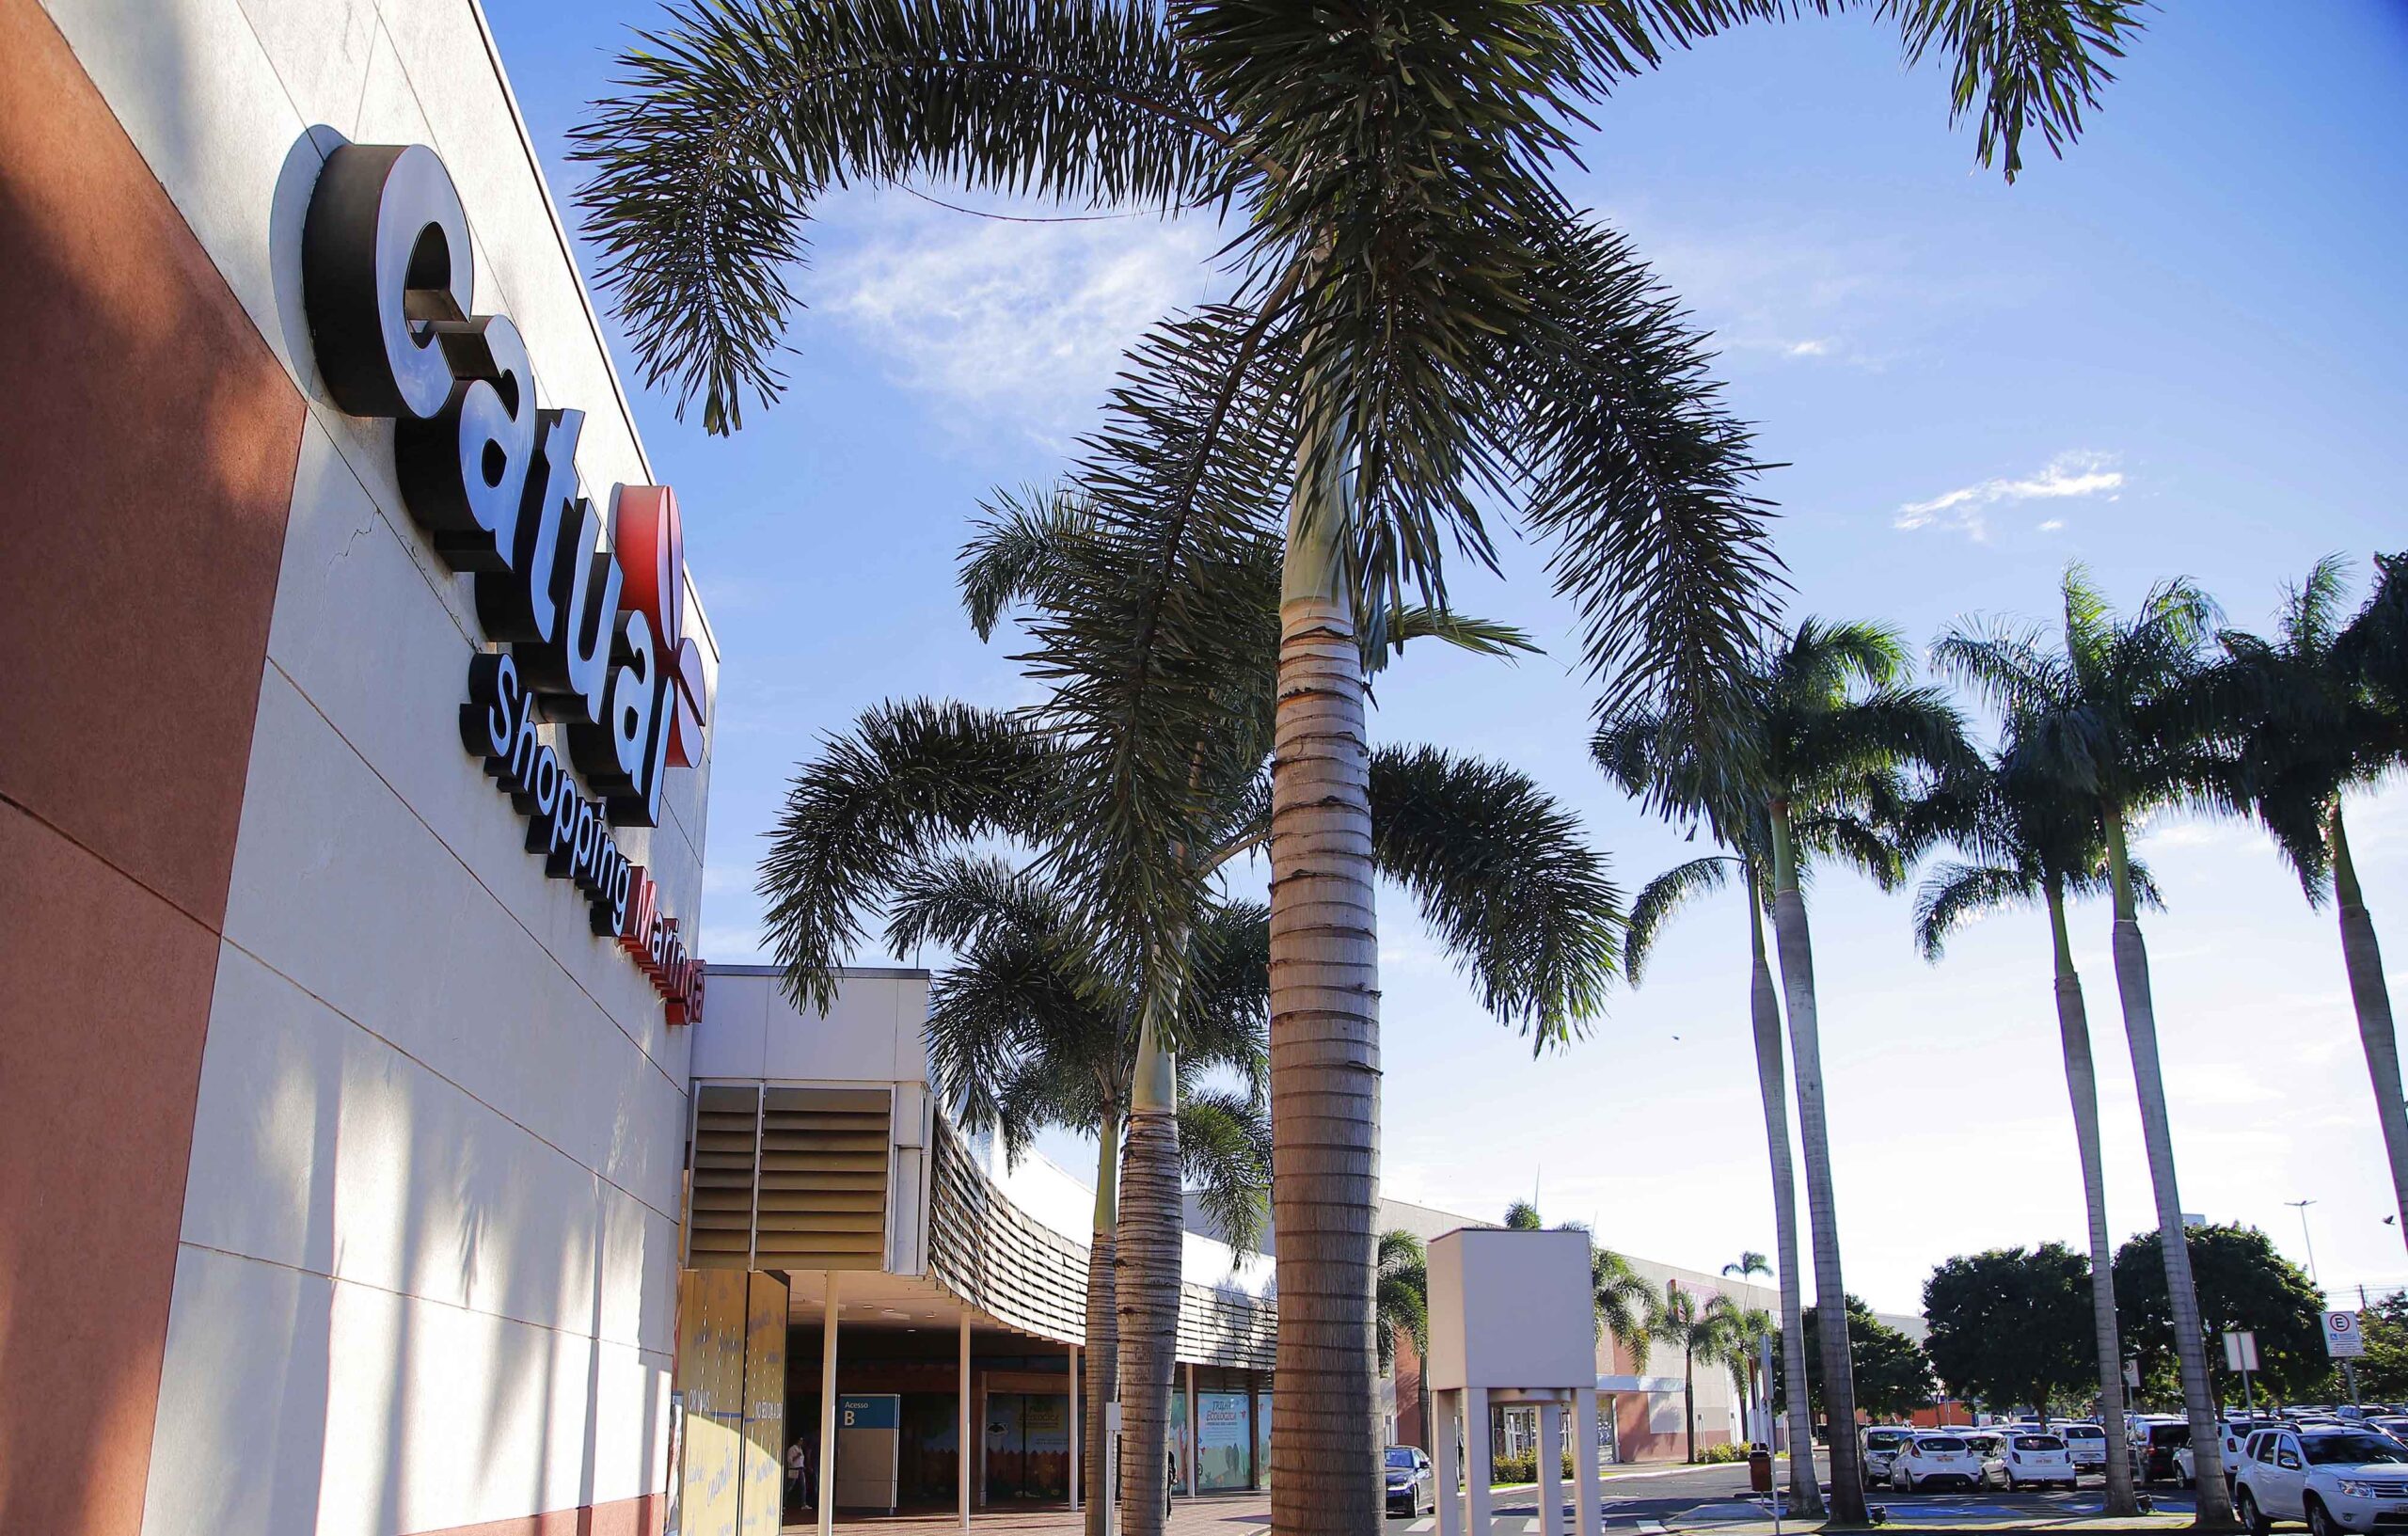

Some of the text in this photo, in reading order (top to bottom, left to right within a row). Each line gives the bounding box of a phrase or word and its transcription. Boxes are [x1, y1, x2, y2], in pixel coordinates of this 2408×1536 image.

[488, 654, 632, 937] Shopping
[2335, 1317, 2345, 1328] E
[844, 1401, 869, 1409] Acesso
[844, 1410, 855, 1426] B
